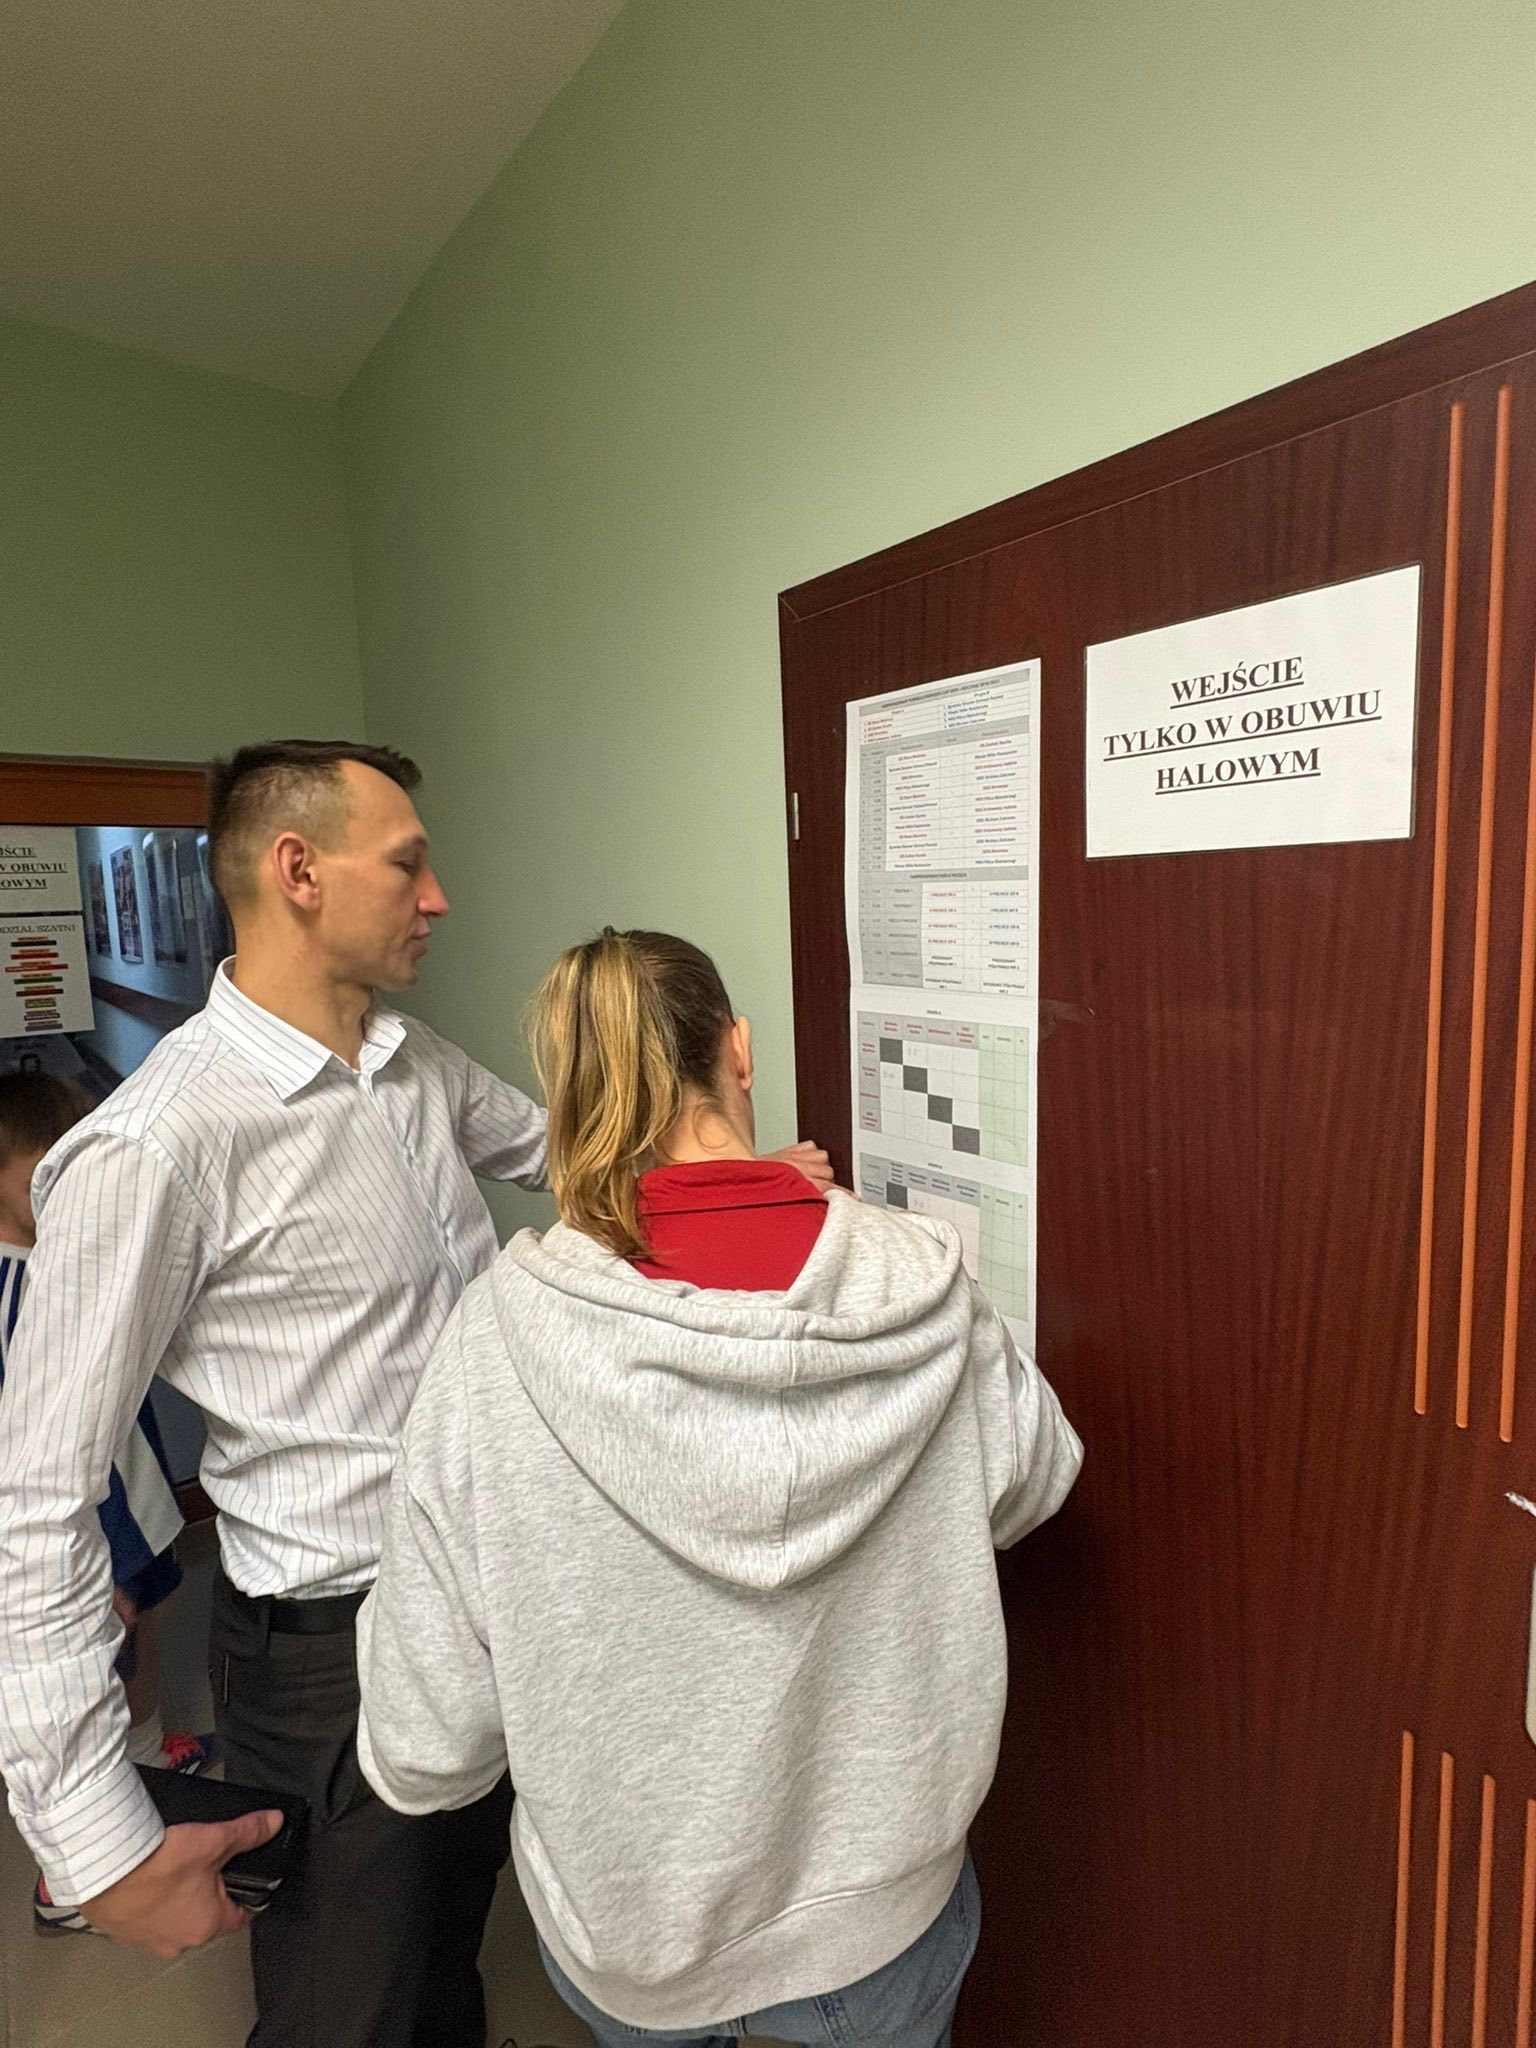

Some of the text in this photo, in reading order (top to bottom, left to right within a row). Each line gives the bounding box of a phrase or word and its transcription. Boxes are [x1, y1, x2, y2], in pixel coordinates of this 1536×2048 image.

[1171, 656, 1304, 703] WEJŚCIE
[1103, 689, 1382, 756] TYLKO W OBUWIU
[1156, 747, 1320, 790] HALOWYM
[11, 863, 67, 872] OBUWIU
